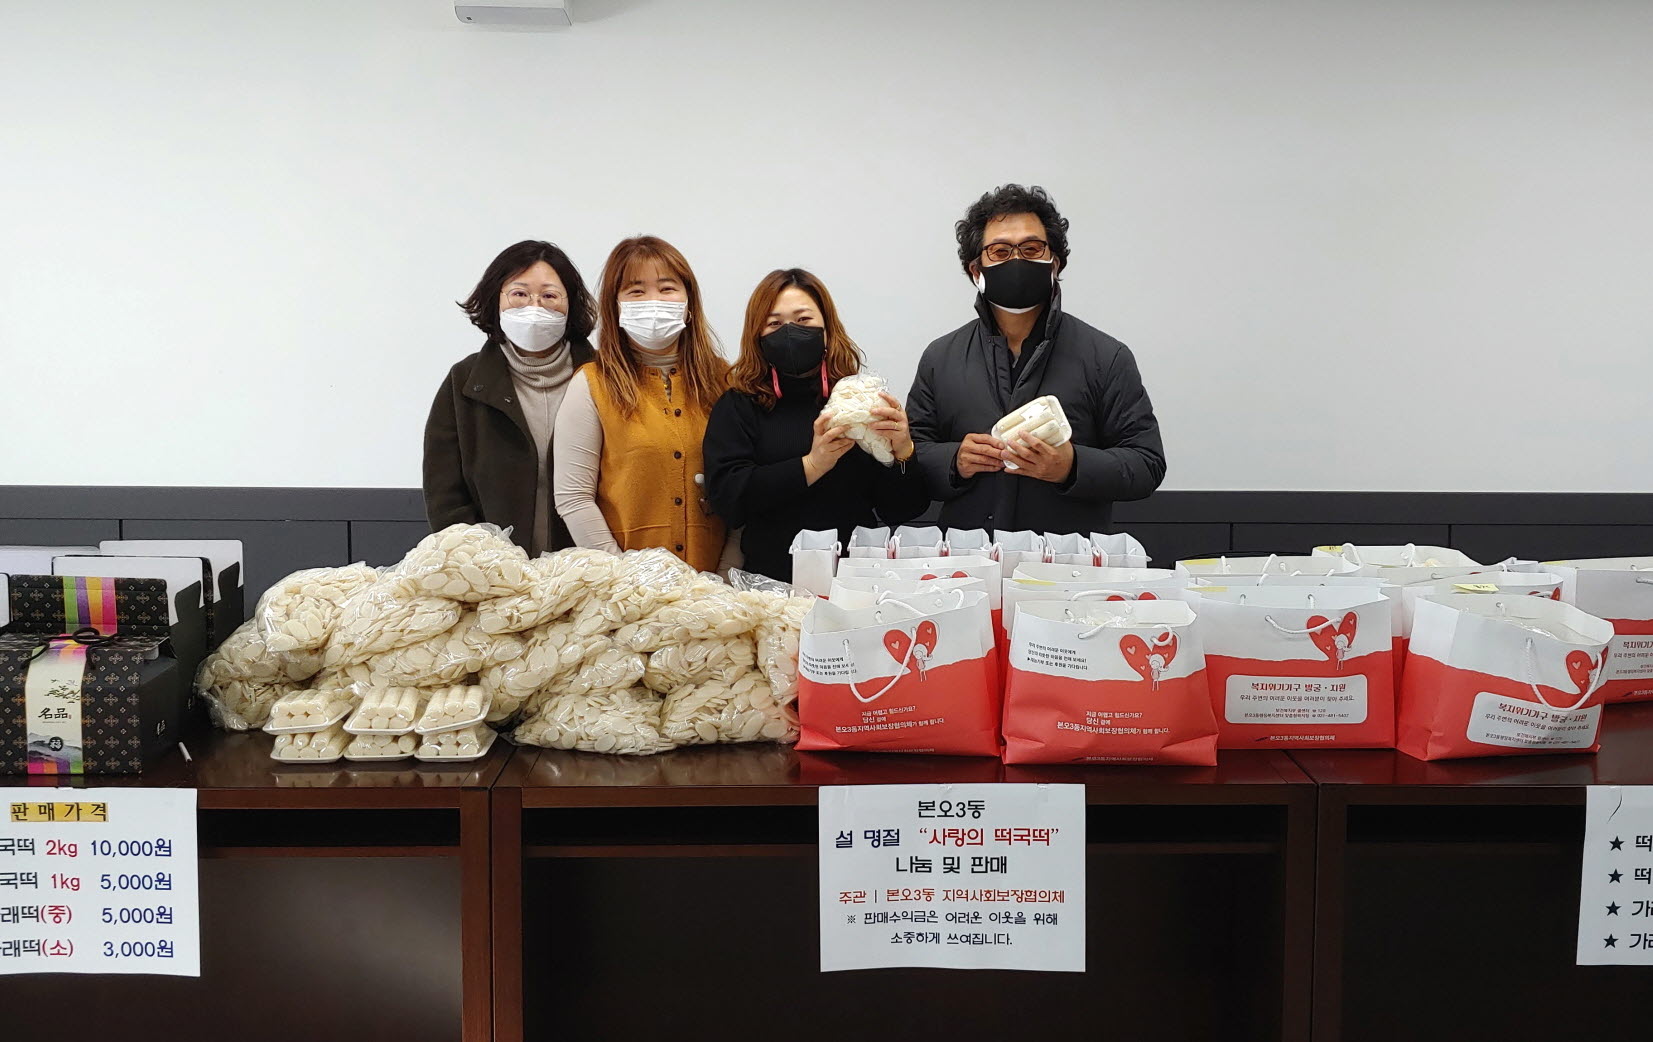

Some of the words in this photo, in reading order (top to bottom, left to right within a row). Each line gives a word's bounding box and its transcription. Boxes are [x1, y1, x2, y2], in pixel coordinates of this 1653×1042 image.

[1251, 682, 1301, 691] 복지위기가구
[1329, 683, 1346, 692] 지원
[38, 707, 68, 720] 名品
[862, 716, 875, 724] 당신
[1086, 717, 1099, 725] 당신
[917, 799, 986, 819] 본오3동
[835, 829, 853, 848] 설
[863, 828, 900, 848] 명절
[919, 827, 984, 848] “사랑의
[994, 827, 1059, 847] 떡국떡”
[46, 839, 78, 858] 2kg
[91, 838, 172, 858] 10,000원
[896, 856, 932, 874] 나눔
[943, 856, 961, 874] 및
[970, 856, 1008, 874] 판매
[0, 872, 39, 889] 국떡
[51, 873, 81, 892] 1kg
[100, 872, 172, 892] 5,000원
[1634, 868, 1652, 885] 떡
[839, 890, 867, 904] 주관
[886, 888, 935, 902] 본오3동
[942, 889, 1065, 904] 지역사회보장협의체
[101, 905, 173, 925] 5,000원
[1631, 900, 1653, 918] 가
[864, 910, 939, 924] 판매수익금은
[945, 911, 983, 924] 어려운
[989, 911, 1027, 925] 이웃을
[1033, 912, 1058, 926] 위해
[890, 932, 941, 945] 소중하게
[946, 932, 1013, 946] 쓰여집니다.
[0, 938, 74, 958] 래떡(소)
[103, 939, 174, 959] 3,000원
